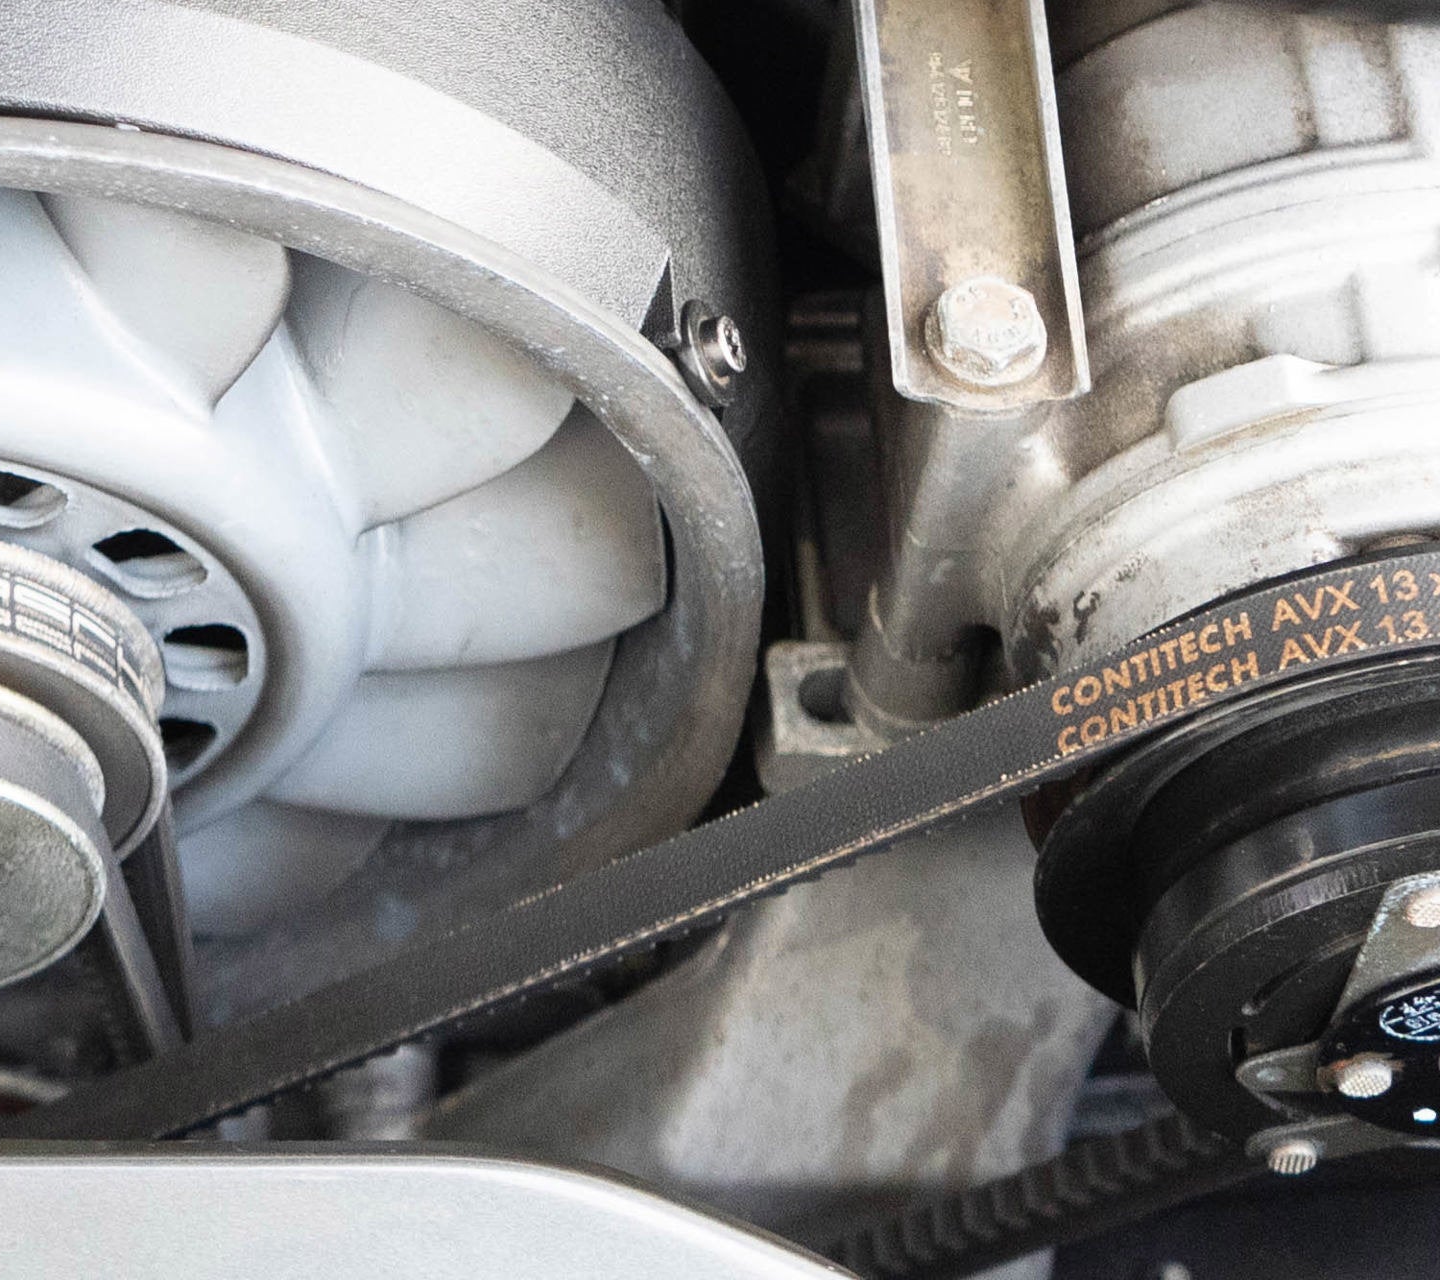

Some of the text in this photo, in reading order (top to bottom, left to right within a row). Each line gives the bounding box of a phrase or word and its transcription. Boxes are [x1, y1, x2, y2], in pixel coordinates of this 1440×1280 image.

[1051, 611, 1253, 716] CONTITECH
[1271, 580, 1361, 632] AVX
[1369, 568, 1420, 605] 13
[1056, 650, 1261, 756] CONTITECH
[1278, 620, 1367, 671] AVX
[1376, 608, 1432, 645] 13
